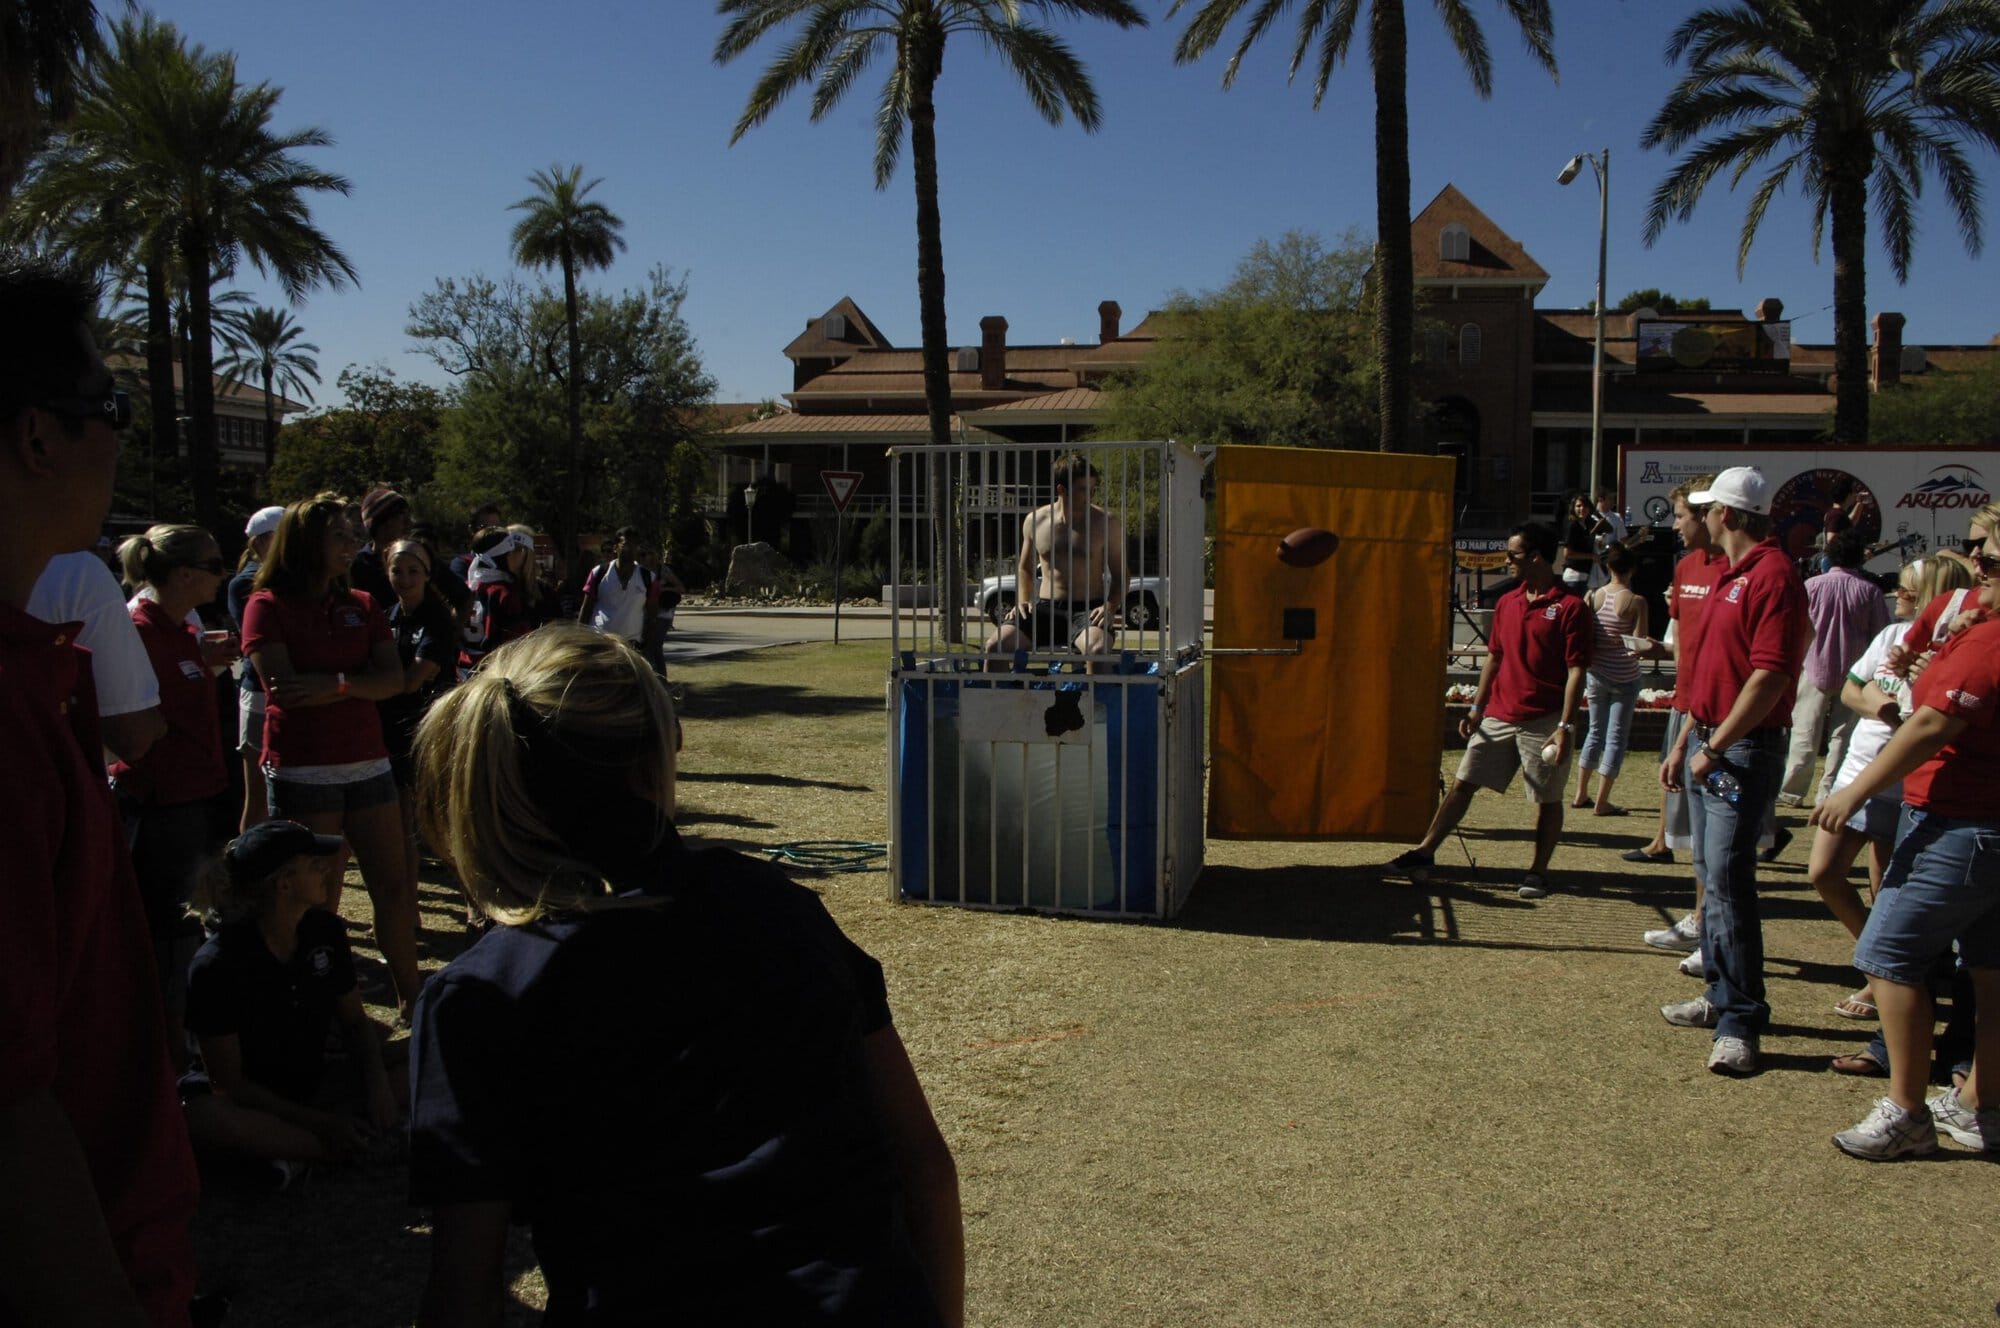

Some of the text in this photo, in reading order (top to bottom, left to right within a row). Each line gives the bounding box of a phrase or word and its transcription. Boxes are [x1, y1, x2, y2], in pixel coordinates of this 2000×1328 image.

[1640, 461, 1663, 483] A
[1895, 493, 1991, 508] ARIZONA
[1936, 535, 1961, 547] Lib
